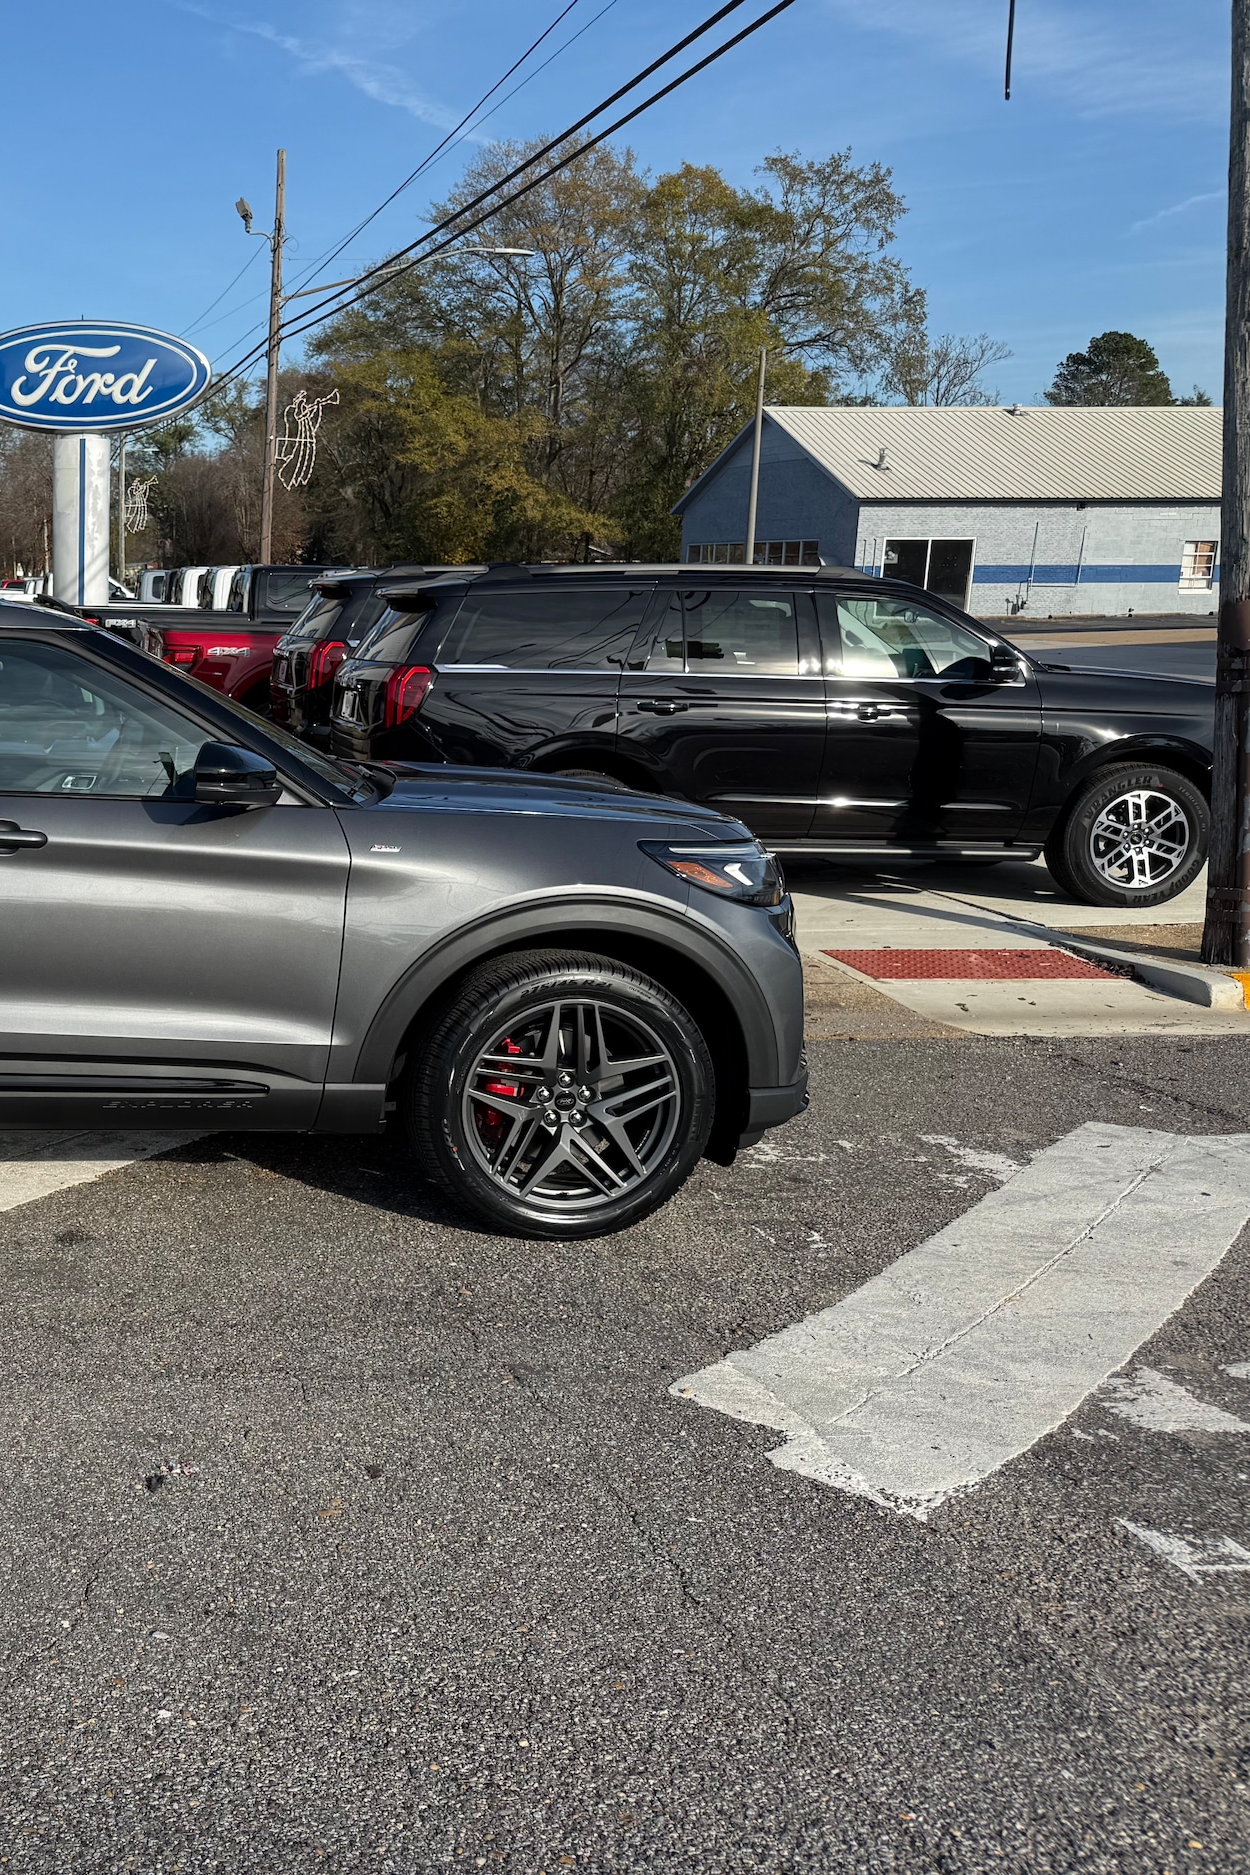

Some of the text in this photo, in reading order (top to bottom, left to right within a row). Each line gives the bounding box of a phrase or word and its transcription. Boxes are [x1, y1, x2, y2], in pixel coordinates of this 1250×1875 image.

[10, 344, 158, 407] Ford
[105, 618, 137, 629] FX4
[1085, 775, 1153, 820] WRANGLER
